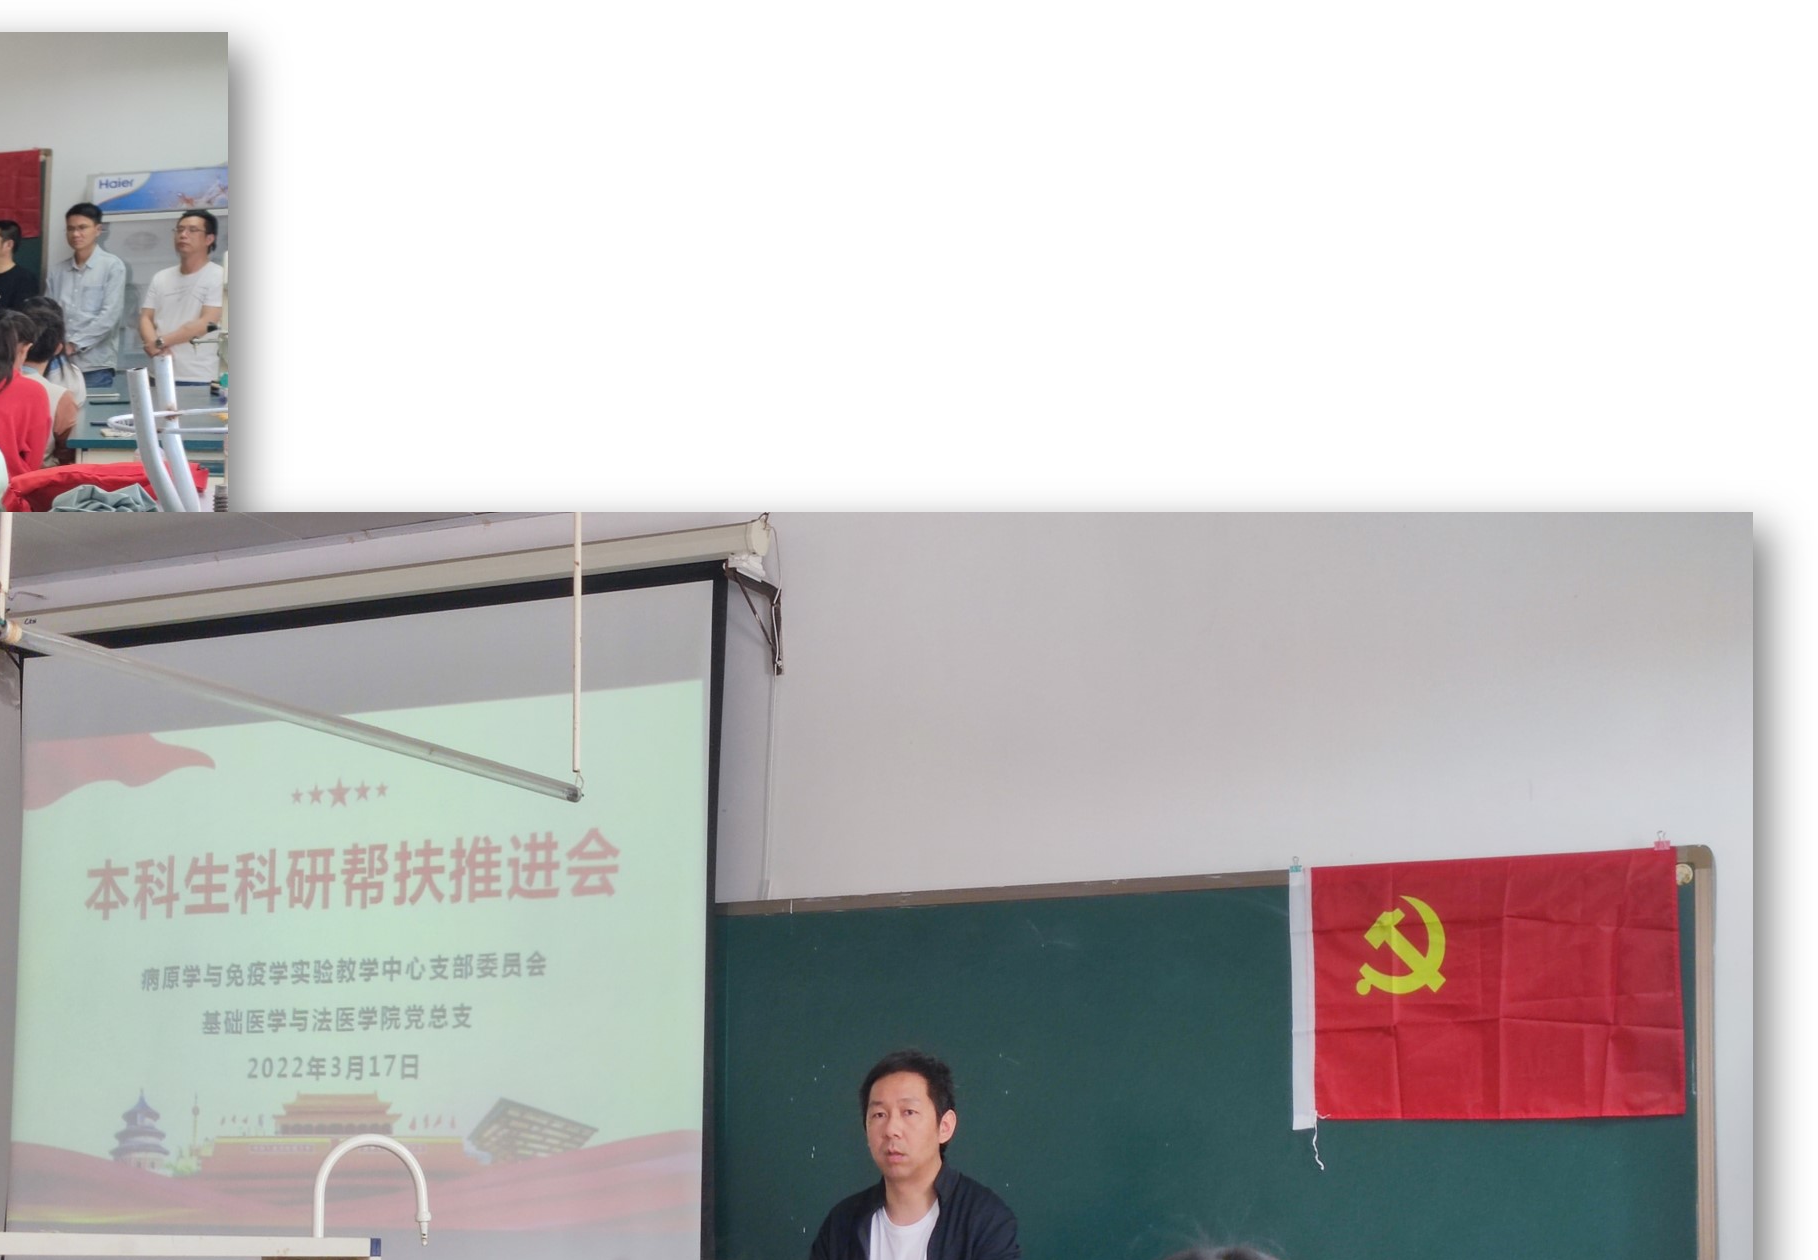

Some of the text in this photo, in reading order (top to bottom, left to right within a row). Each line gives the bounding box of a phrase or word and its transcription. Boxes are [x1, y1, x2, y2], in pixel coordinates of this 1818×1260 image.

[98, 178, 134, 189] Haier
[84, 827, 621, 921] 本科生科研帮扶推进会
[141, 950, 547, 993] 病原学与免疫学实验教学中心支部委员会
[201, 1003, 474, 1037] 基础医学与法医学院党总支
[246, 1053, 421, 1082] 2022年3月17日
